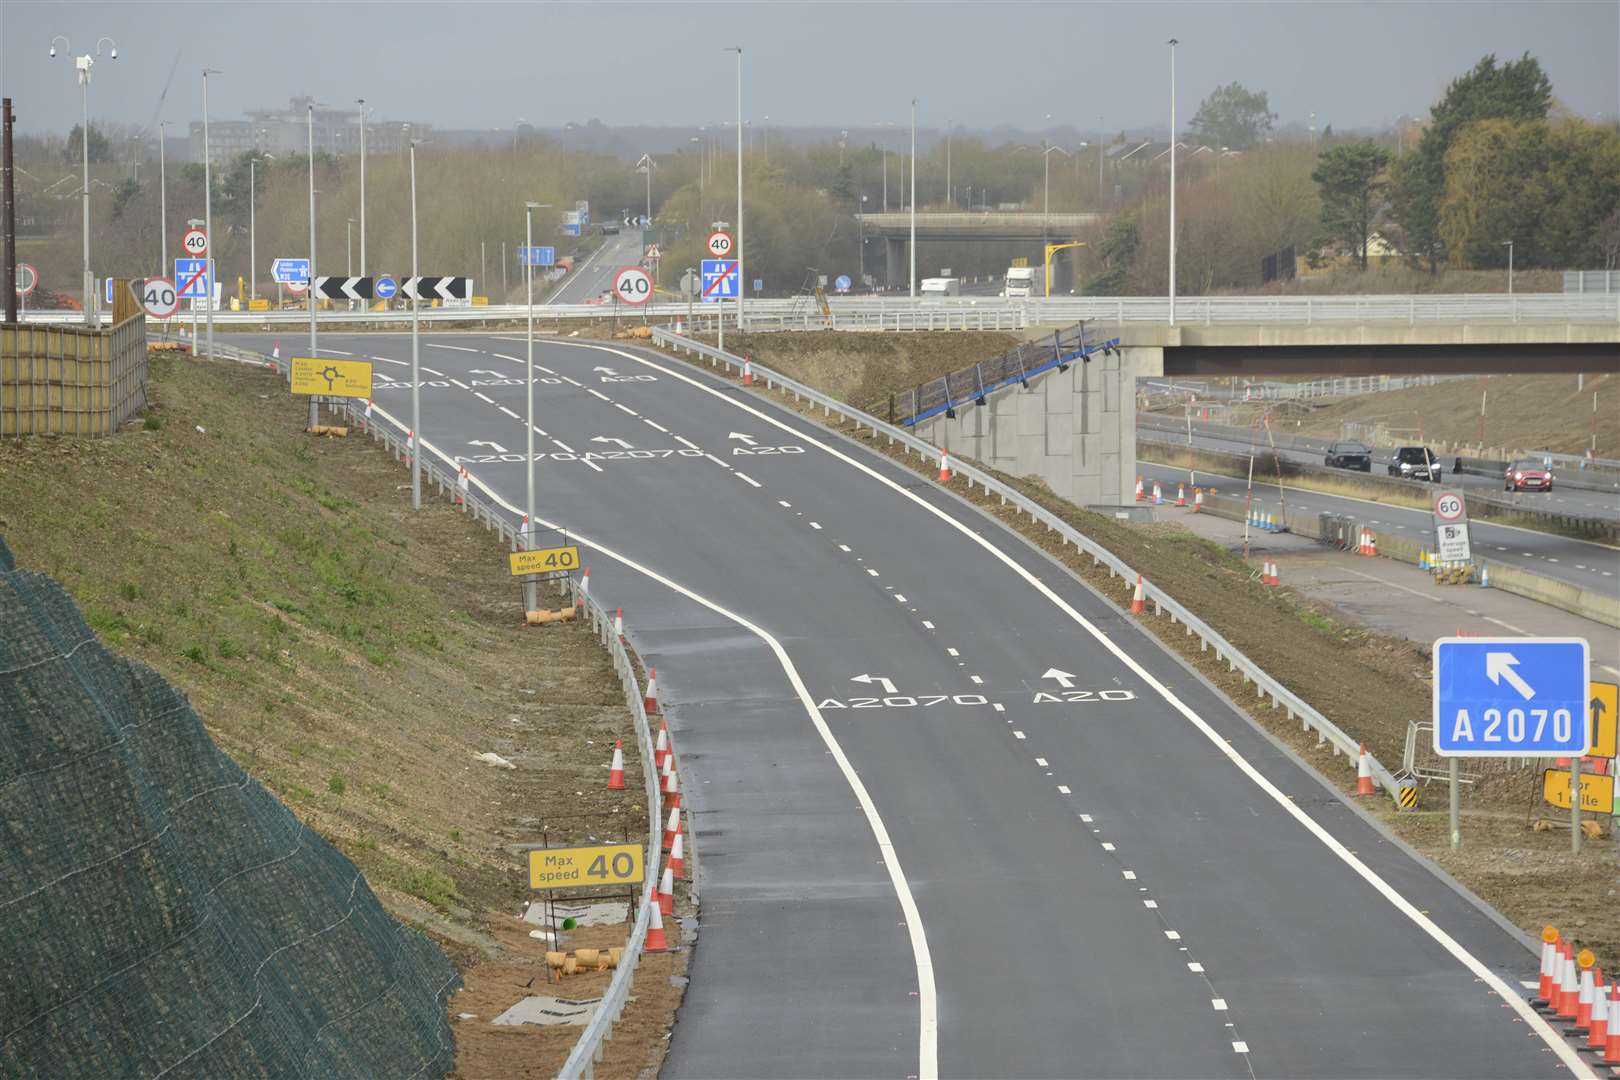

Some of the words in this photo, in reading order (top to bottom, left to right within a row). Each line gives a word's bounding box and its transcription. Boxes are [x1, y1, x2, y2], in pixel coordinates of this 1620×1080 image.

[186, 237, 205, 248] 40
[711, 239, 729, 250] 40
[620, 278, 649, 294] 40
[145, 289, 175, 307] 40
[601, 375, 658, 383] A20
[373, 381, 450, 390] 2070
[585, 449, 706, 459] A2070
[733, 446, 804, 456] A20
[455, 453, 577, 463] A2070
[1440, 501, 1459, 512] 60
[545, 552, 573, 567] 40
[516, 563, 541, 571] speed
[818, 694, 988, 709] A2070
[1033, 689, 1136, 704] A20
[1557, 792, 1563, 802] 1
[545, 856, 574, 867] Max
[587, 852, 634, 878] 40
[539, 867, 580, 882] speed
